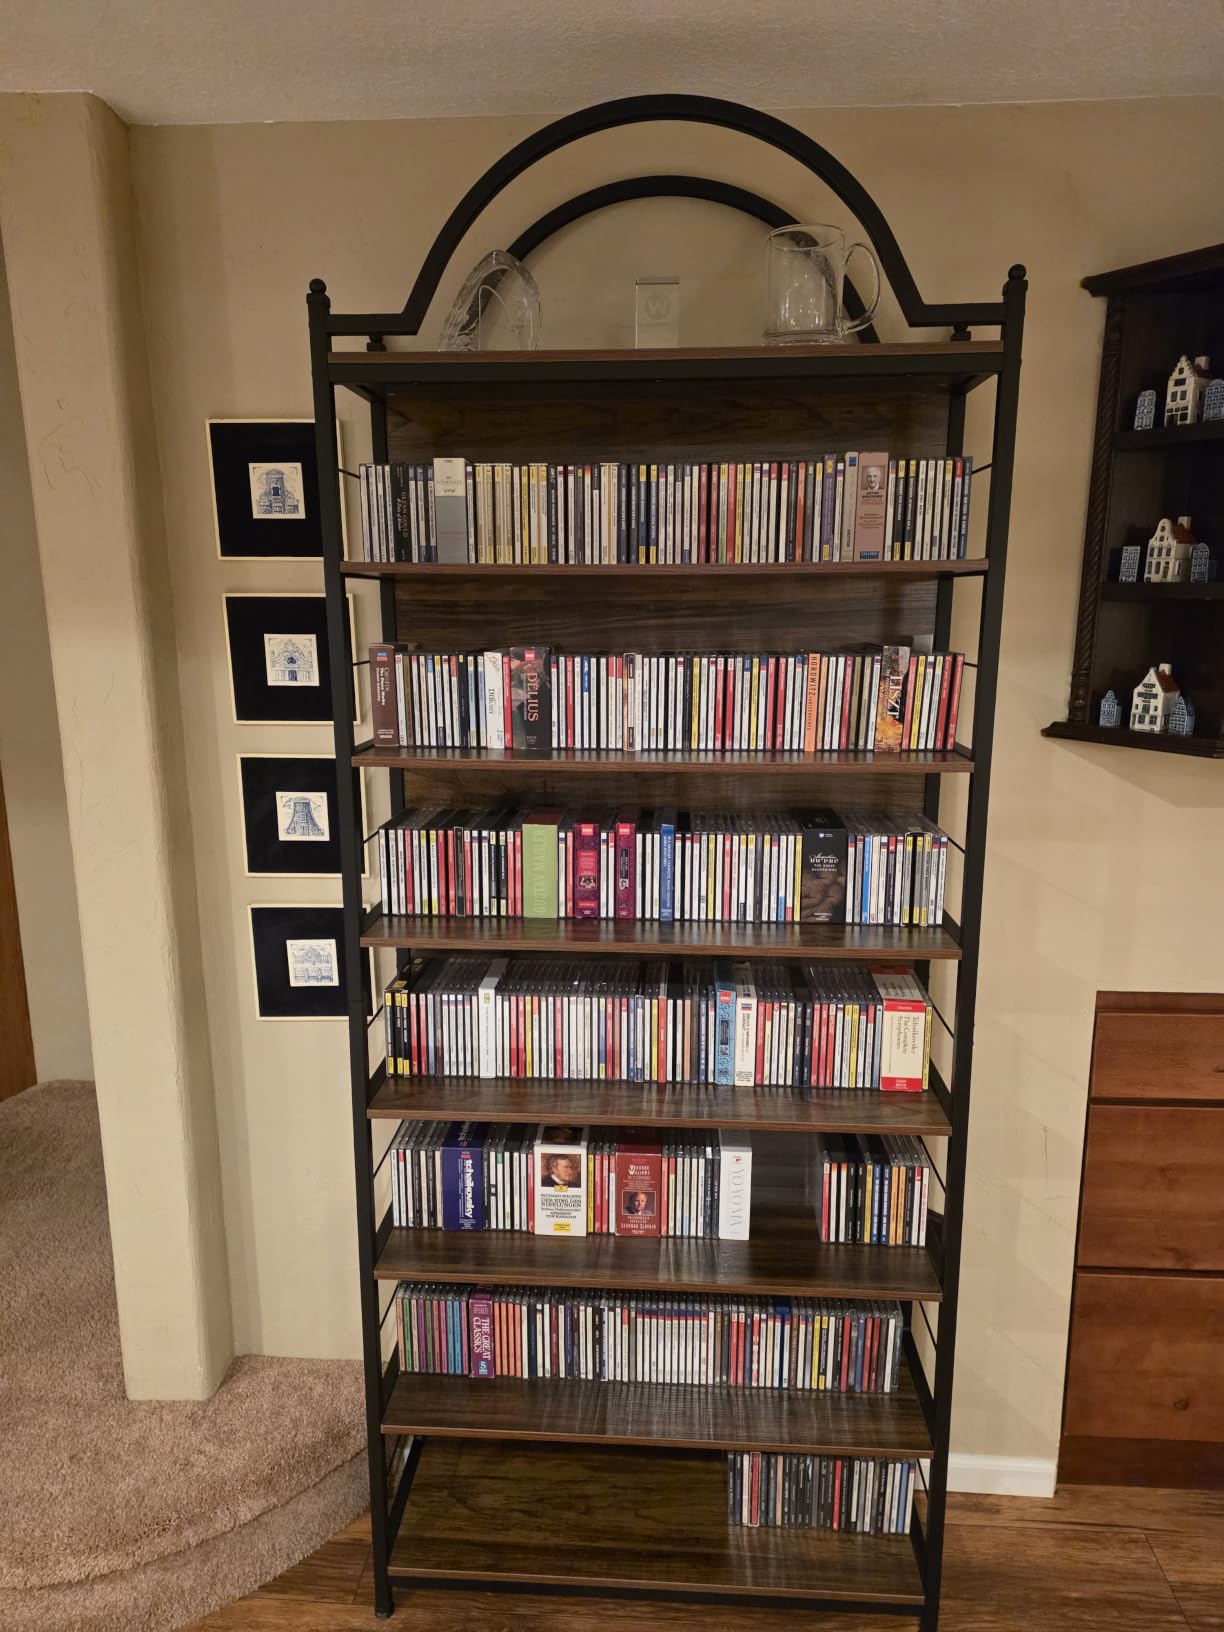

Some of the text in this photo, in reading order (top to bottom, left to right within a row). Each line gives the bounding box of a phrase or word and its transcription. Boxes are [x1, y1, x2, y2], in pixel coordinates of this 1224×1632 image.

[527, 672, 539, 722] DELIUS
[809, 656, 818, 696] HOROWITZ
[887, 676, 903, 720] LISZT
[911, 1016, 920, 1054] Tchaikovsky
[465, 1159, 475, 1218] tchaikovsky
[473, 1317, 482, 1353] CLASSICS
[482, 1317, 491, 1361] THE GREAT
